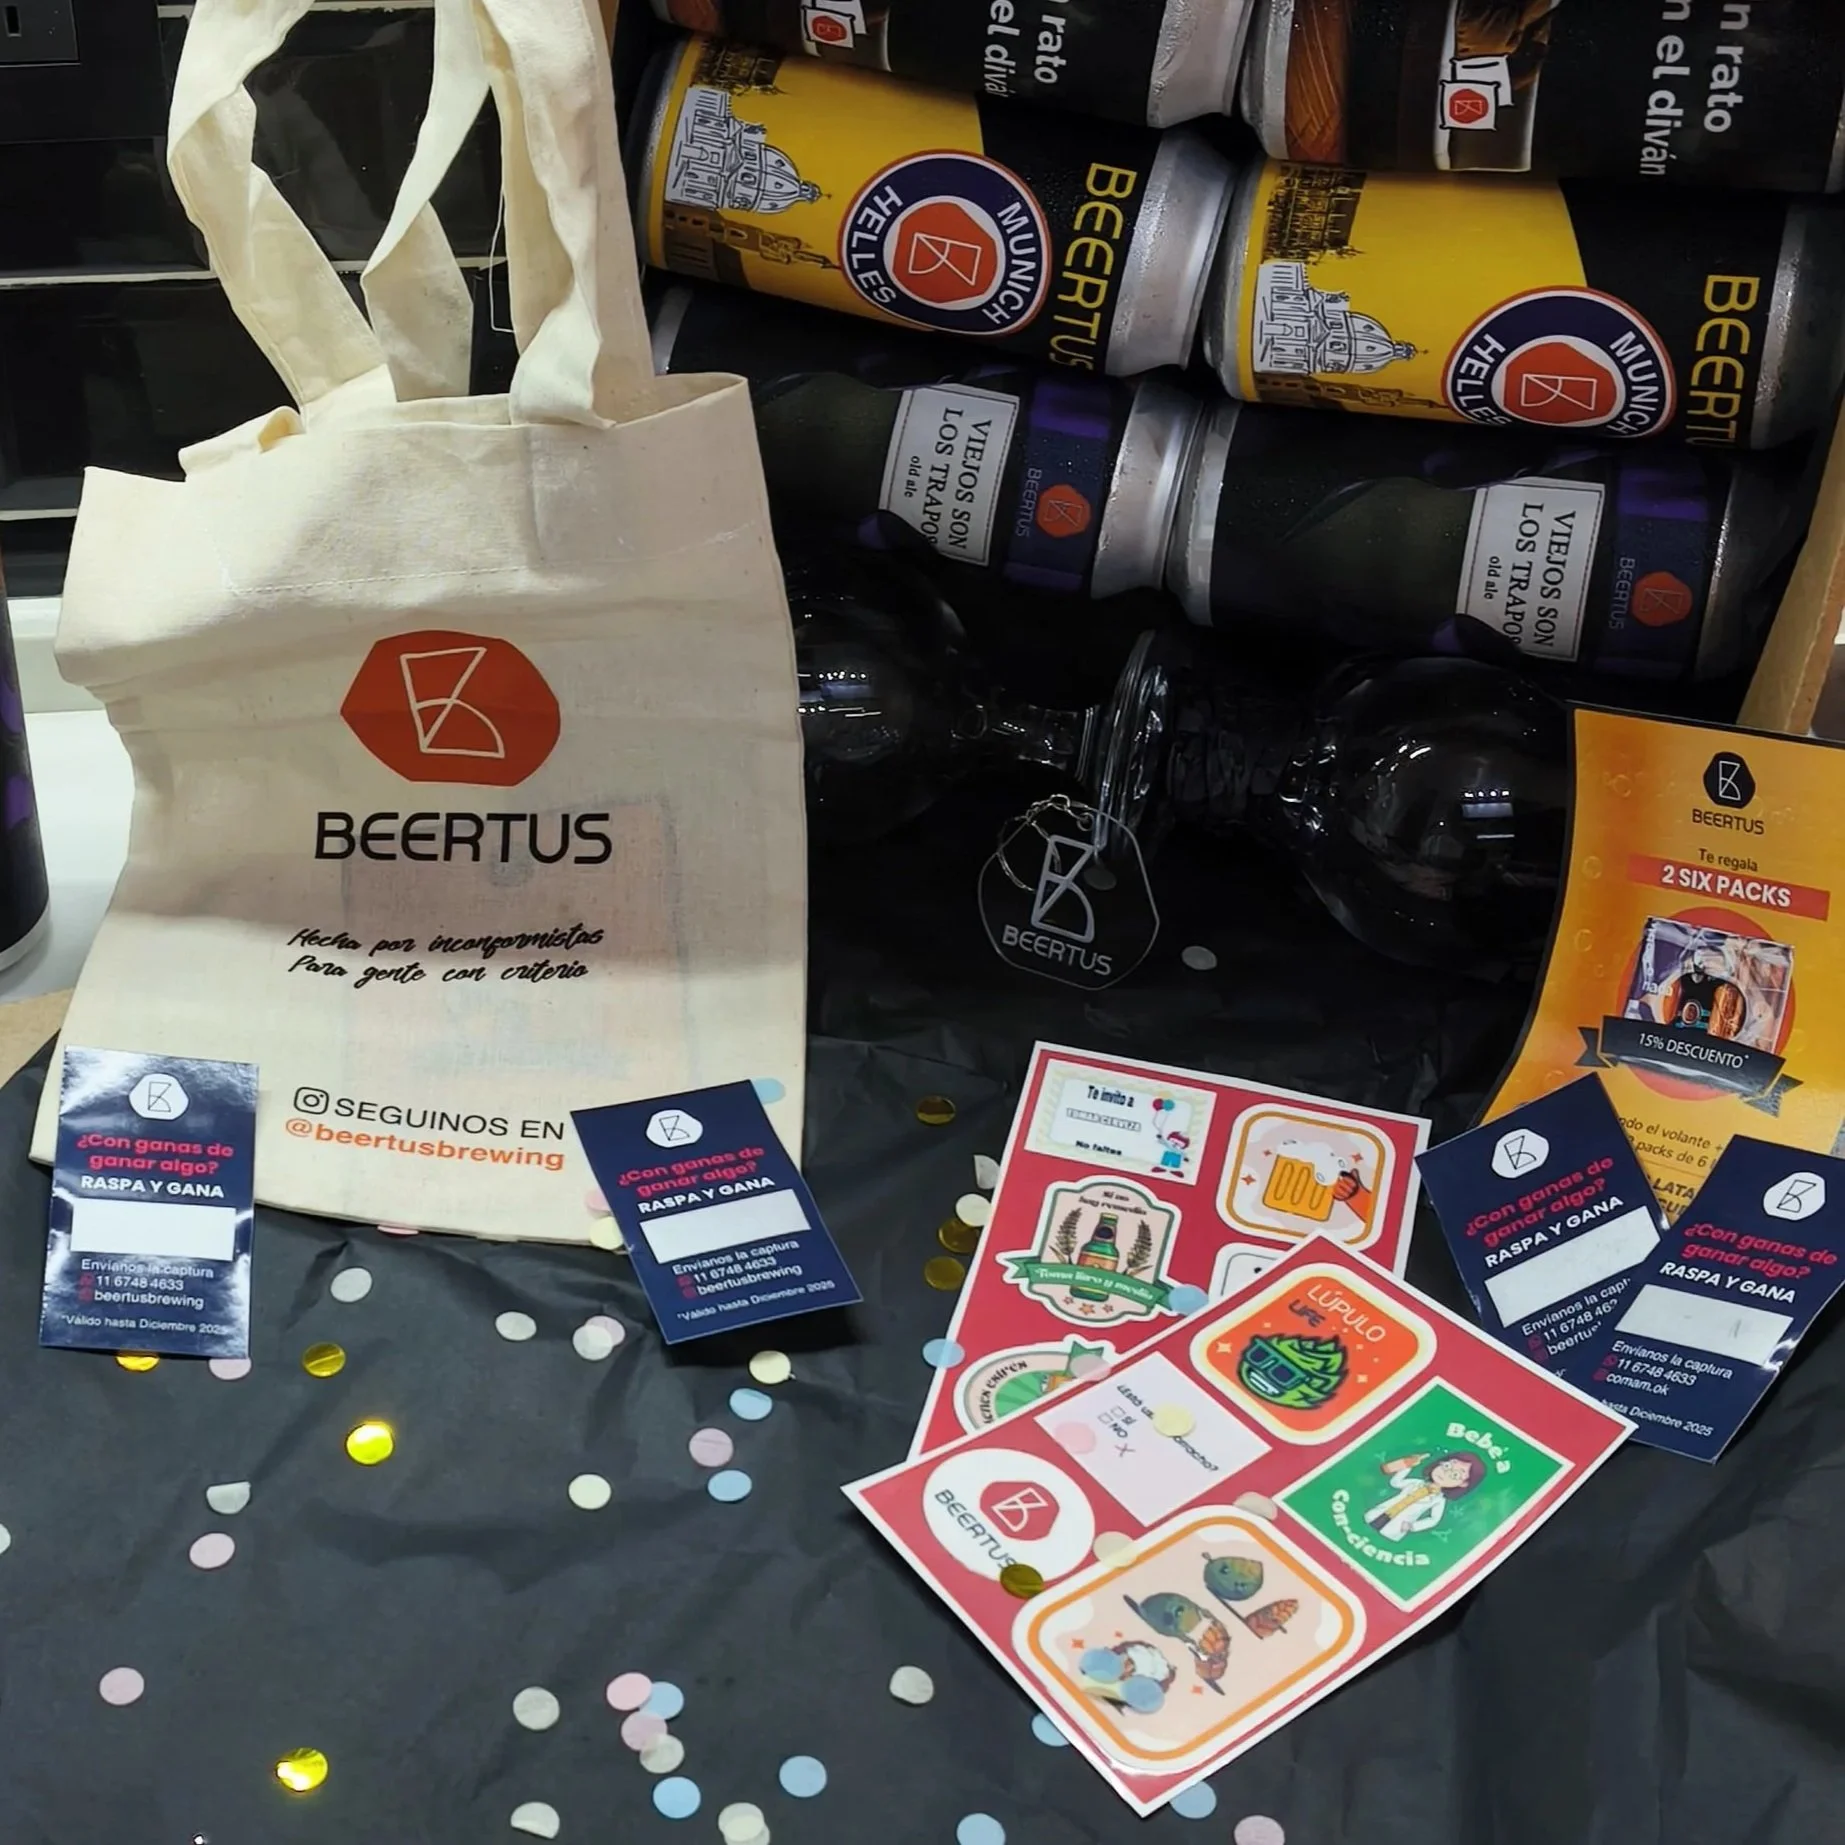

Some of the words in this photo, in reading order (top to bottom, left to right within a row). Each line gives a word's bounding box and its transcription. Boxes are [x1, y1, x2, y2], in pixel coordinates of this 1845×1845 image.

[987, 0, 1020, 36] el
[1720, 3, 1751, 30] n
[1034, 14, 1067, 84] rato
[1652, 35, 1690, 79] el
[1704, 46, 1744, 133] rato
[1639, 90, 1684, 175] diván
[846, 185, 903, 305] HELLES
[981, 200, 1037, 325] MUNICH
[1049, 162, 1137, 371] BEERTUS
[1685, 274, 1760, 449] BEERTU
[1606, 329, 1660, 436] MUNICH
[934, 407, 964, 456] LOS
[908, 455, 920, 477] old
[955, 419, 992, 504] VIEJOS
[904, 479, 918, 498] ale
[1015, 467, 1042, 537] BEERTUS
[949, 507, 971, 549] SON
[1516, 502, 1544, 553] LOS
[1488, 556, 1502, 578] old
[1540, 511, 1576, 600] VIEJOS
[1484, 580, 1499, 600] ale
[1608, 557, 1635, 630] BEERTUS
[1534, 605, 1559, 647] SON
[314, 811, 613, 865] BEERTUS
[1692, 808, 1765, 835] BEERTUS
[1699, 848, 1715, 864] Te
[1718, 855, 1758, 872] regala
[1662, 864, 1675, 884] 2
[1679, 868, 1713, 892] SIX
[1716, 875, 1791, 908] PACKS
[287, 927, 361, 950] Hecha
[369, 936, 416, 957] por
[428, 922, 605, 959] inconformistas
[1002, 924, 1113, 976] BEERTUS
[288, 954, 347, 977] Para
[354, 960, 426, 988] gente
[442, 965, 487, 982] con
[500, 958, 589, 982] criterio
[1639, 1033, 1664, 1050] 15%
[334, 1098, 508, 1137] SEGUINOS
[521, 1119, 564, 1140] EN
[1646, 1124, 1660, 1135] el
[1662, 1128, 1711, 1149] volante
[77, 1132, 131, 1150] ¿Con
[134, 1137, 203, 1156] ganas
[205, 1140, 234, 1157] de
[285, 1117, 565, 1171] @beertusbrewing
[1635, 1140, 1674, 1159] packs
[1676, 1150, 1694, 1164] de
[1697, 1155, 1709, 1168] 6
[89, 1152, 155, 1171] ganar
[159, 1157, 219, 1176] algo?
[619, 1165, 668, 1186] ¿Con
[671, 1153, 734, 1176] ganas
[738, 1145, 765, 1160] de
[635, 1175, 698, 1198] ganar
[701, 1161, 757, 1183] algo?
[80, 1175, 146, 1193] RASPA
[149, 1180, 164, 1194] Y
[166, 1182, 225, 1198] GANA
[637, 1193, 701, 1214] RASPA
[700, 1188, 715, 1200] Y
[718, 1176, 775, 1197] GANA
[1465, 1203, 1516, 1236] ¿Con
[1517, 1171, 1585, 1212] ganas
[1586, 1156, 1614, 1176] de
[1482, 1208, 1546, 1248] ganar
[1549, 1177, 1605, 1213] algo?
[735, 1251, 749, 1262] la
[749, 1239, 800, 1257] captura
[1484, 1231, 1549, 1268] RASPA
[1548, 1222, 1562, 1237] Y
[1565, 1196, 1624, 1229] GANA
[1684, 1223, 1738, 1245] ¿Con
[1736, 1233, 1806, 1261] ganas
[1809, 1248, 1838, 1266] de
[162, 1263, 214, 1279] captura
[694, 1270, 708, 1283] 11
[709, 1262, 743, 1280] 6748
[743, 1256, 777, 1273] 4633
[696, 1265, 803, 1296] beertusbrewing
[1681, 1243, 1749, 1268] ganar
[1749, 1258, 1811, 1281] algo?
[94, 1288, 204, 1311] beertusbrewing
[97, 1274, 111, 1287] 11
[114, 1275, 146, 1289] 6748
[147, 1277, 184, 1291] 4633
[718, 1298, 749, 1312] hasta
[750, 1286, 806, 1304] Diciembre
[1585, 1293, 1599, 1306] la
[1600, 1277, 1631, 1300] capt
[1659, 1261, 1723, 1289] RASPA
[1724, 1275, 1741, 1290] Y
[1739, 1279, 1796, 1304] GANA
[104, 1315, 136, 1329] hasta
[139, 1317, 196, 1333] Diciembre
[1288, 1299, 1326, 1328] LIFE
[1307, 1284, 1387, 1343] LÚPULO
[1543, 1327, 1560, 1341] 11
[1560, 1312, 1593, 1334] 6748
[1617, 1358, 1632, 1370] 11
[1631, 1361, 1664, 1379] 6748
[1662, 1369, 1698, 1387] 4633
[1670, 1353, 1685, 1367] la
[1684, 1360, 1734, 1379] captura
[1629, 1404, 1684, 1428] Diciembre
[1683, 1420, 1714, 1437] 2025
